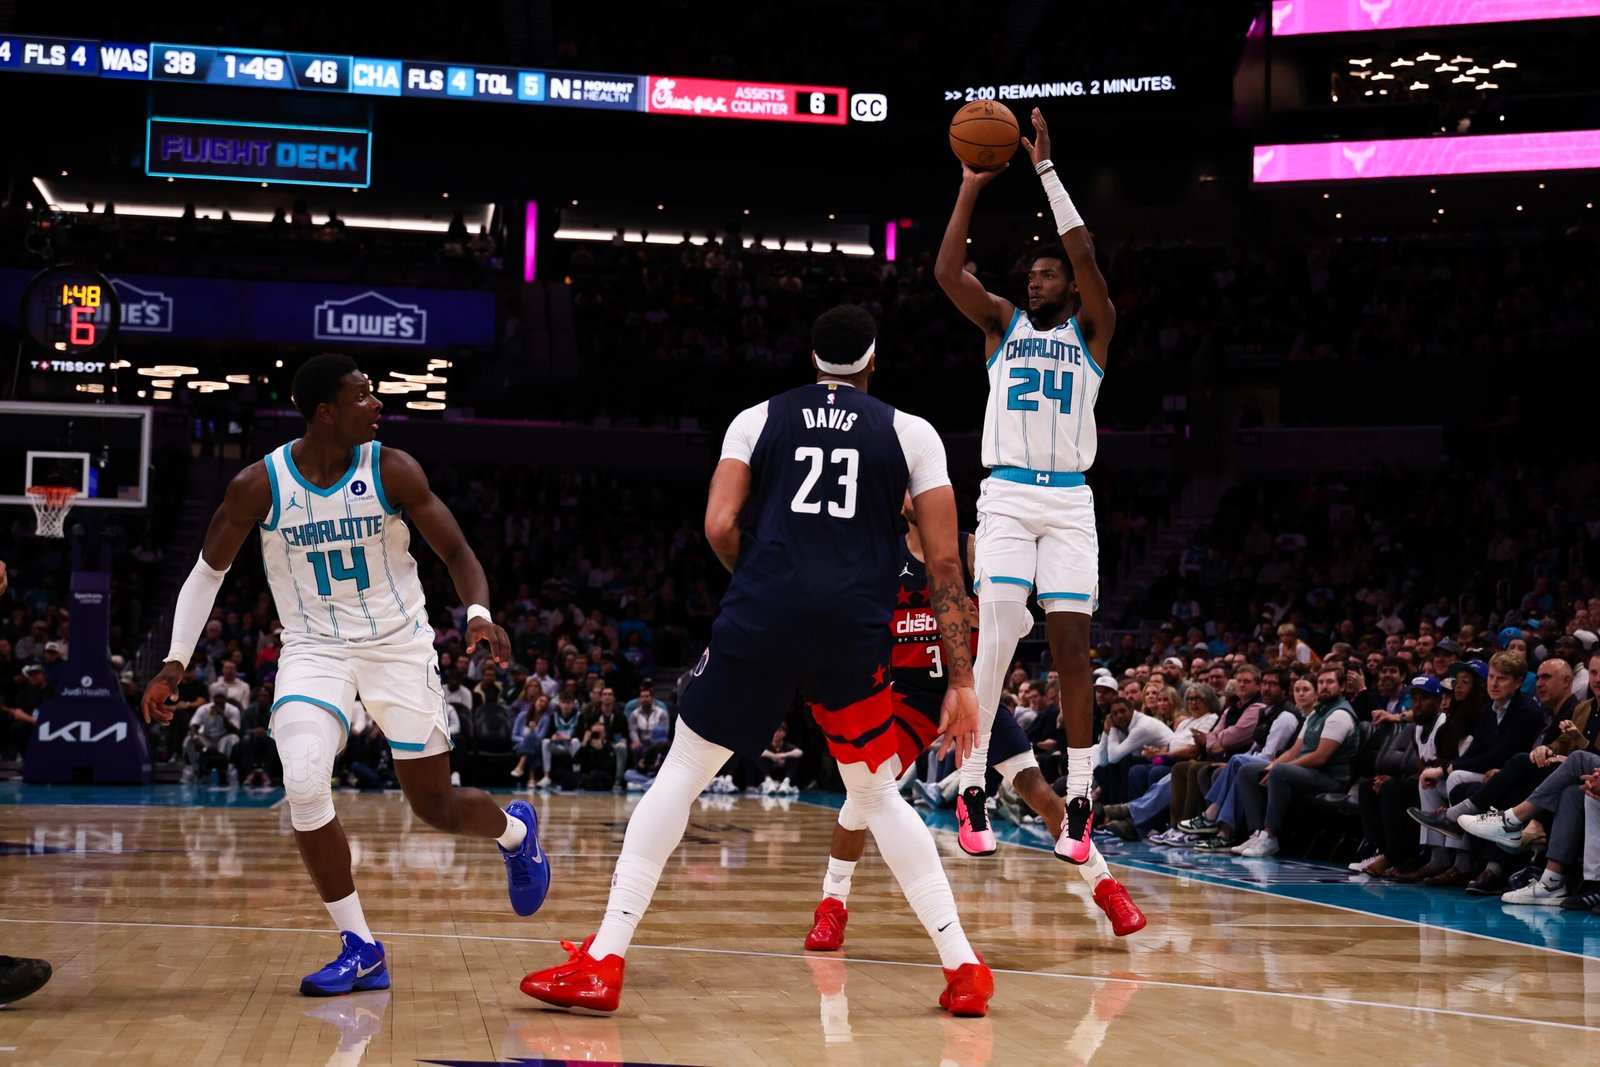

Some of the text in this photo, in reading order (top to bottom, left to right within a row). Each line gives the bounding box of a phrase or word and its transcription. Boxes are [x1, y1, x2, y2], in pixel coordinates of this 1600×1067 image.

[24, 43, 66, 66] FLS
[71, 46, 87, 66] 4
[101, 47, 148, 72] WAS
[164, 51, 539, 96] 38 1:49 46 CHA FLS 4 TOL 5
[584, 80, 634, 94] NOVANT
[584, 91, 629, 103] HEALTH
[735, 87, 785, 102] ASSISTS
[965, 86, 996, 101] 2:00
[999, 82, 1086, 99] REMAINING.
[1090, 80, 1101, 95] 2
[1103, 76, 1176, 94] MINUTES.
[731, 100, 788, 116] COUNTER
[810, 92, 826, 114] 6
[855, 99, 882, 117] CC
[162, 135, 358, 171] FLIGHT DECK
[63, 284, 101, 307] 1:48
[70, 306, 96, 345] 6
[327, 309, 415, 337] LOWE'S
[1005, 337, 1081, 366] CHARLOTTE
[51, 360, 105, 373] TISSOT
[1007, 367, 1073, 414] 24
[802, 407, 858, 432] DAVIS
[790, 446, 860, 519] 23
[281, 515, 383, 547] CHARLOTTE
[306, 546, 371, 596] 14
[926, 645, 943, 678] 3
[62, 687, 110, 697] Judi Health
